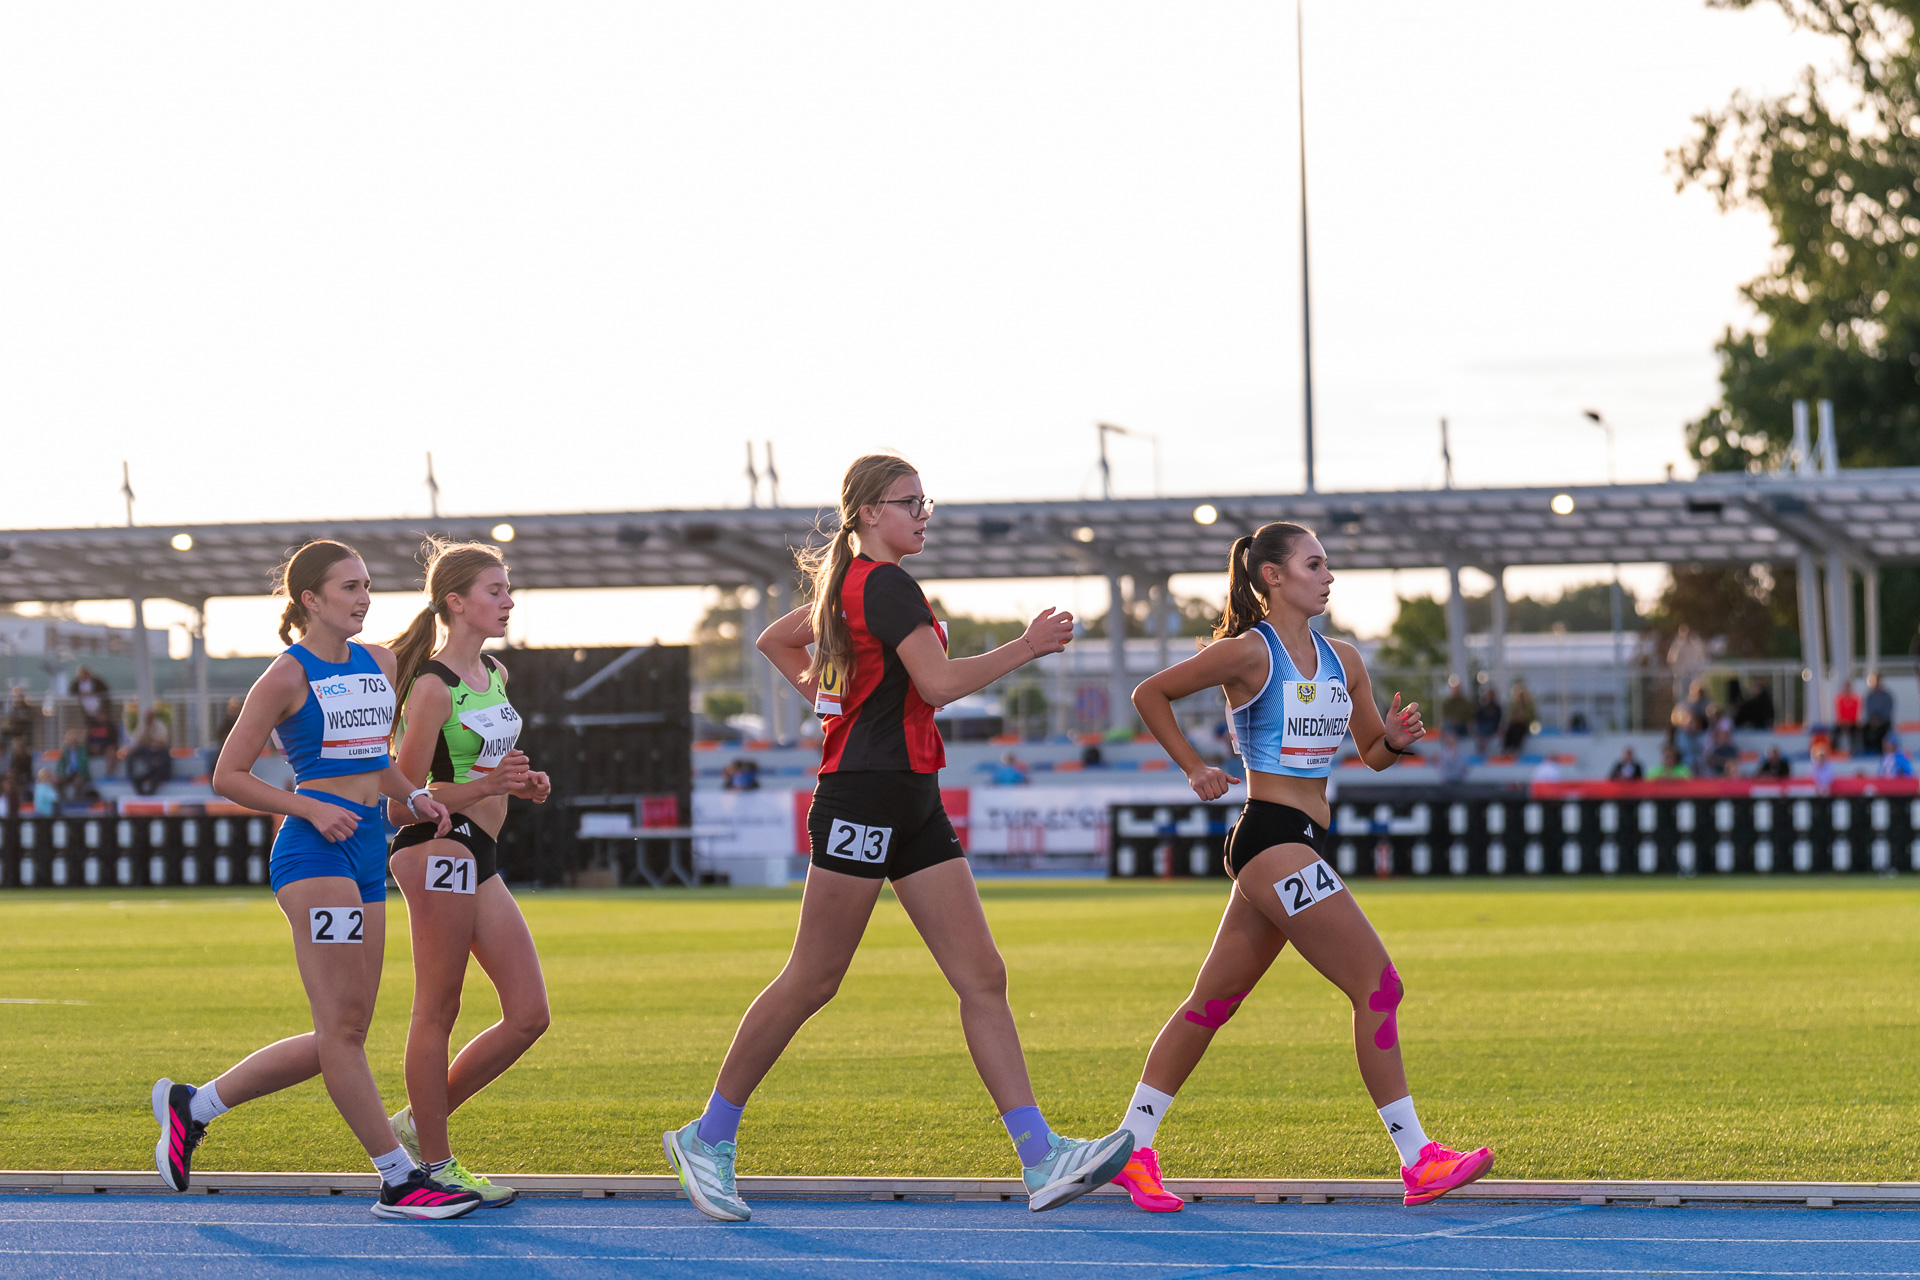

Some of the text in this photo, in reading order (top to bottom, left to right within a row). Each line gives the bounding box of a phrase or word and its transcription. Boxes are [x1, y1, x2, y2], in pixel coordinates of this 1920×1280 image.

[358, 678, 387, 694] 703
[1330, 686, 1348, 703] 796
[327, 706, 393, 730] WŁOSZCZYNA
[500, 707, 518, 722] 458
[1287, 713, 1349, 737] NIEDŹWIEDŹ
[348, 747, 370, 756] LUBIN
[1306, 757, 1320, 765] LUBIN
[833, 824, 885, 861] 23
[432, 859, 468, 891] 21
[1284, 863, 1336, 911] 24
